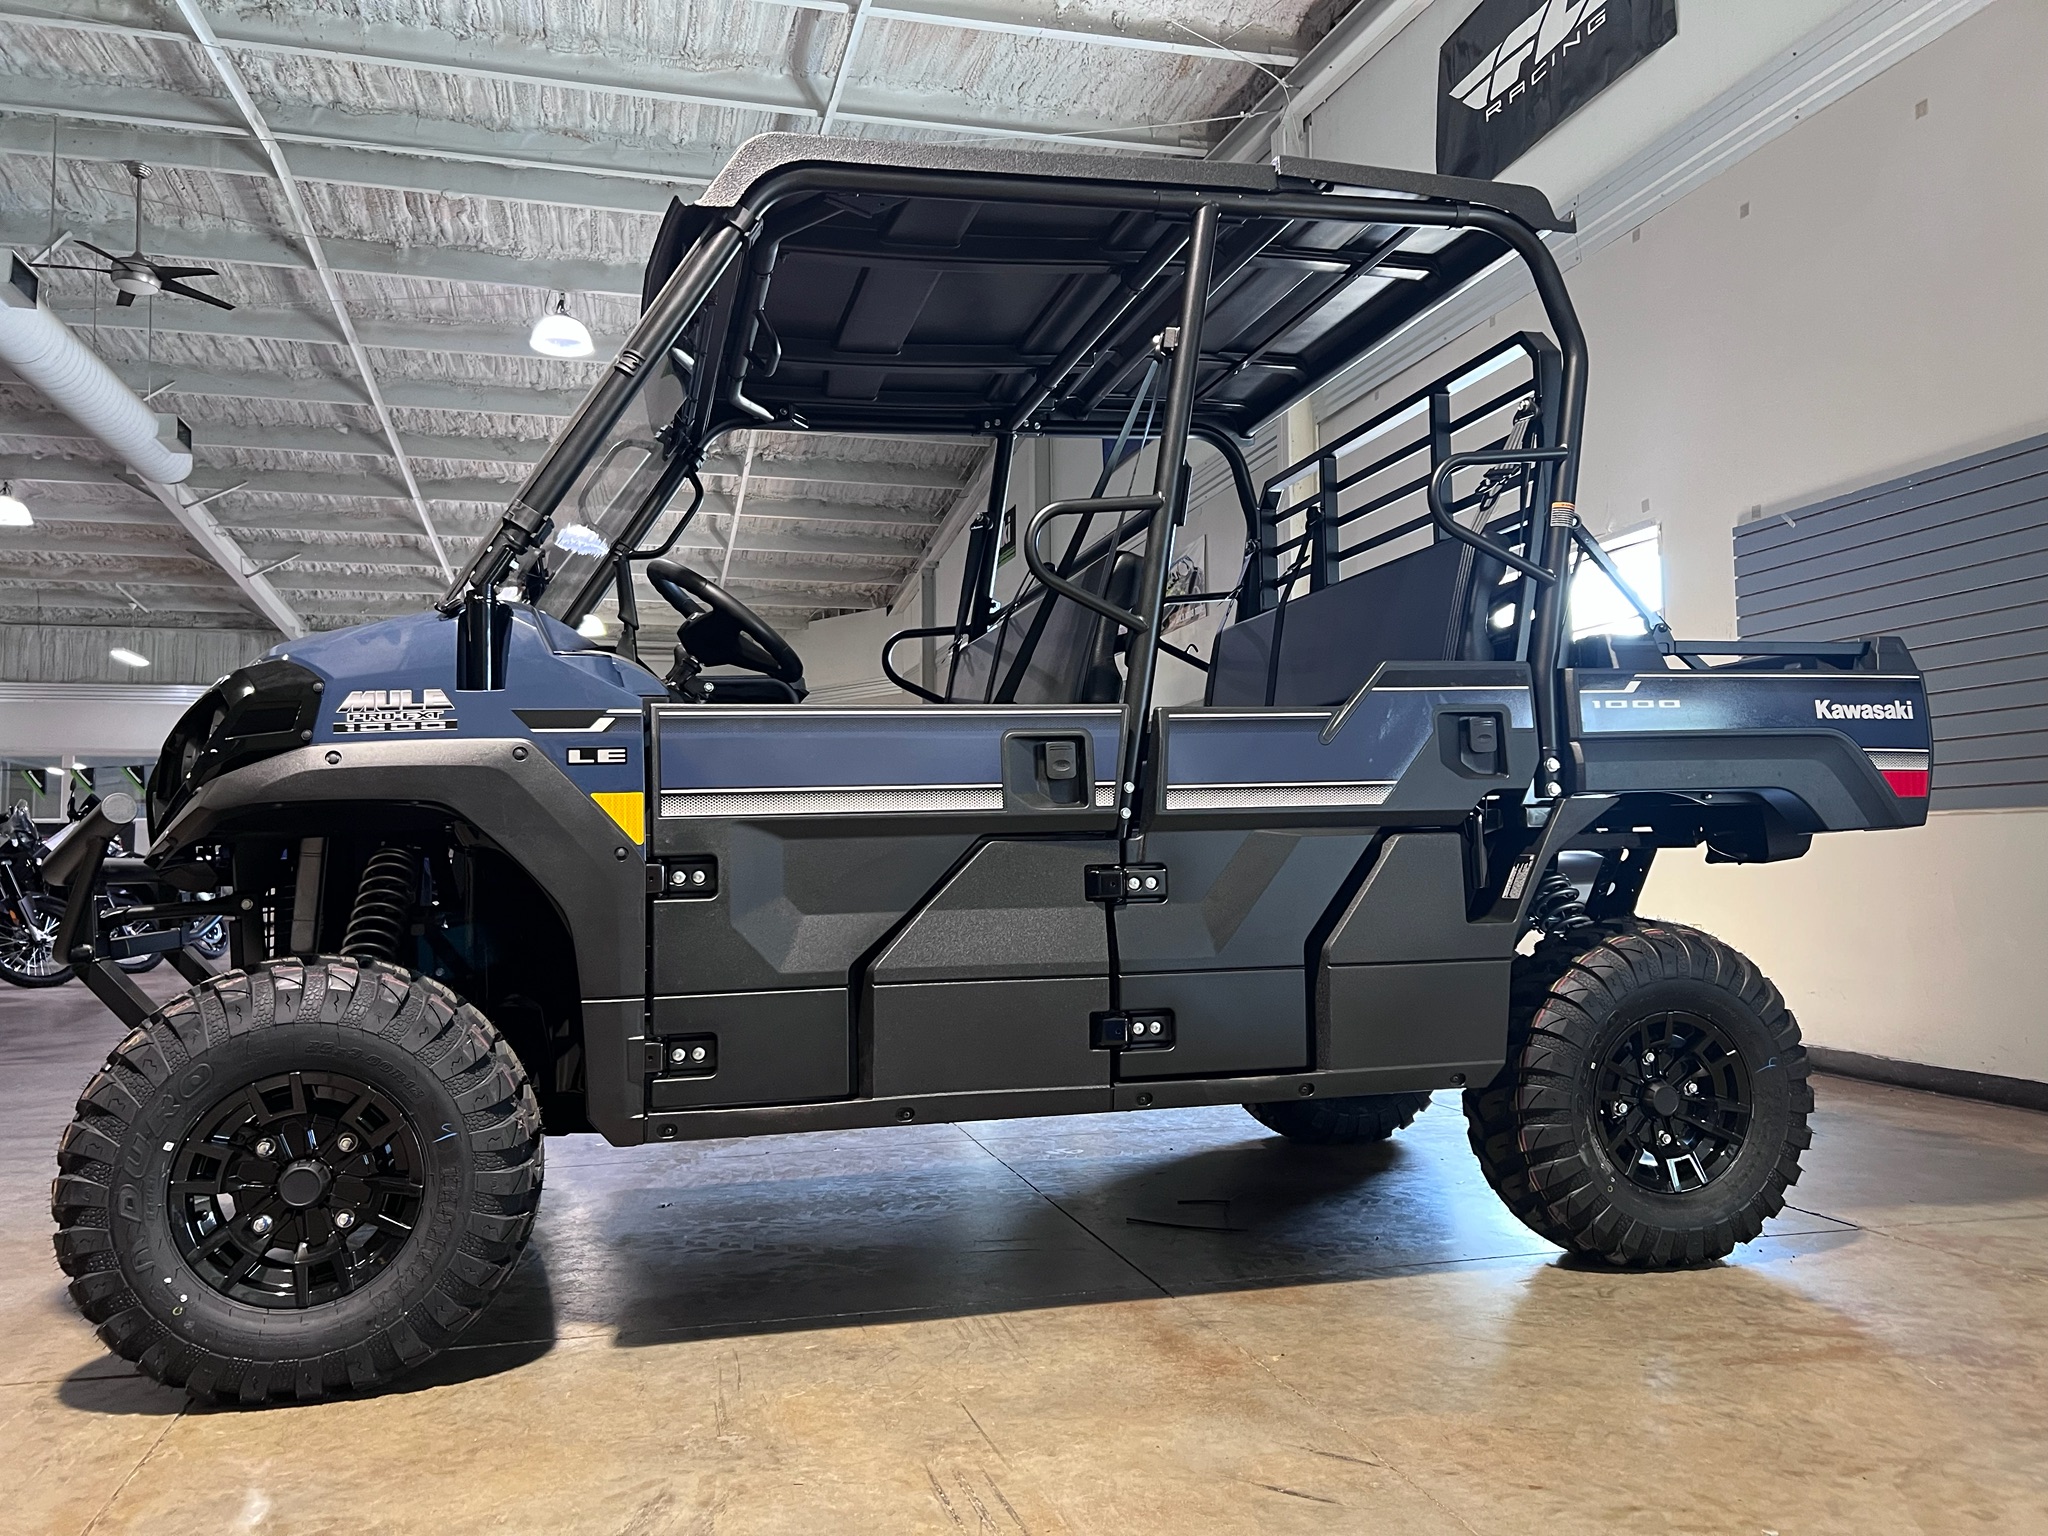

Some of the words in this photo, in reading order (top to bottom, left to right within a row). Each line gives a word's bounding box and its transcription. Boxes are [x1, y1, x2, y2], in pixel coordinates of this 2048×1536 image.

[1485, 8, 1606, 122] RACING
[336, 688, 456, 713] MULE
[1591, 700, 1681, 709] 1000
[1814, 699, 1914, 721] Kawasaki
[344, 721, 447, 733] 1000
[568, 748, 627, 764] LE
